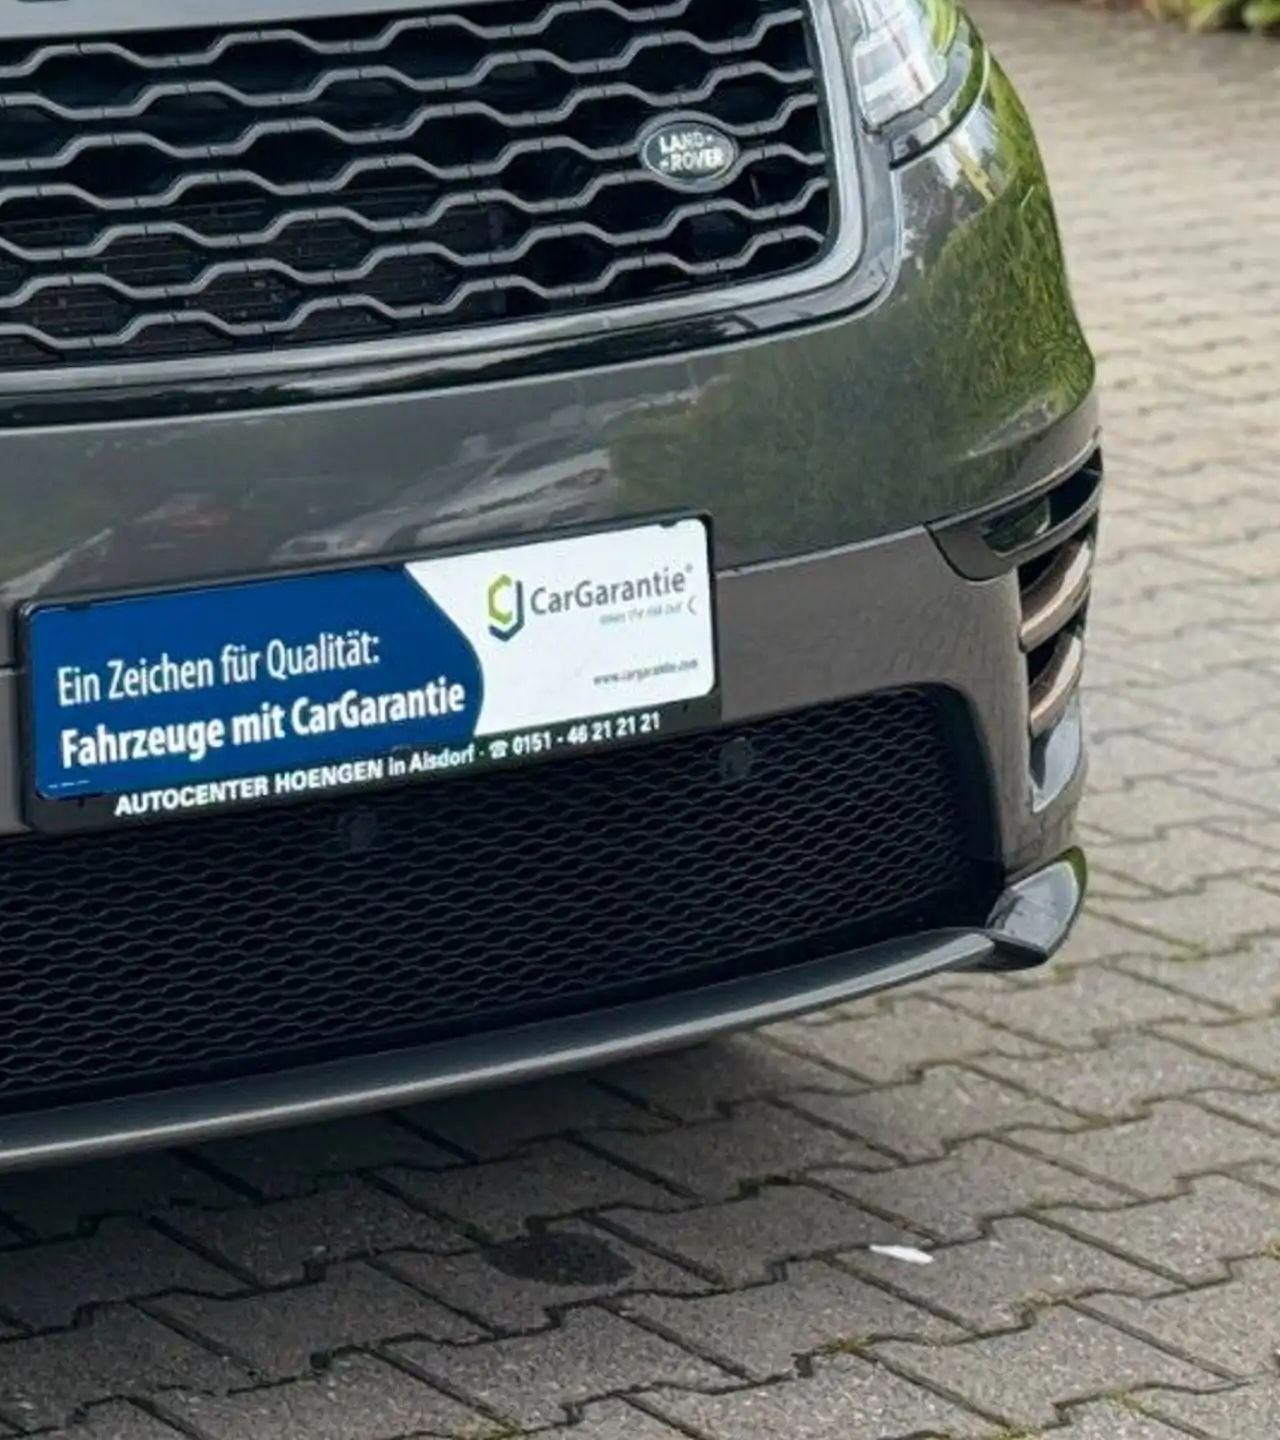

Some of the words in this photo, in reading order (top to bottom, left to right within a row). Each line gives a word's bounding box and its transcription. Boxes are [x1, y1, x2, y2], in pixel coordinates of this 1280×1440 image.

[659, 132, 705, 154] LAND
[57, 664, 101, 707] Ein
[107, 652, 214, 700] Zeichen
[220, 642, 261, 686] für
[266, 629, 381, 681] Qualität:
[61, 722, 225, 770] Fahrzeuge
[231, 700, 286, 746] mit
[290, 674, 467, 736] CarGarantie
[114, 773, 269, 817] AUTOCENTER
[274, 758, 384, 795] HOENGEN
[388, 756, 406, 777] in
[408, 742, 476, 774] Alsdorf
[512, 730, 553, 756] 0151
[566, 723, 589, 746] 46
[591, 719, 613, 743] 21
[615, 715, 637, 738] 21
[639, 710, 661, 734] 21
